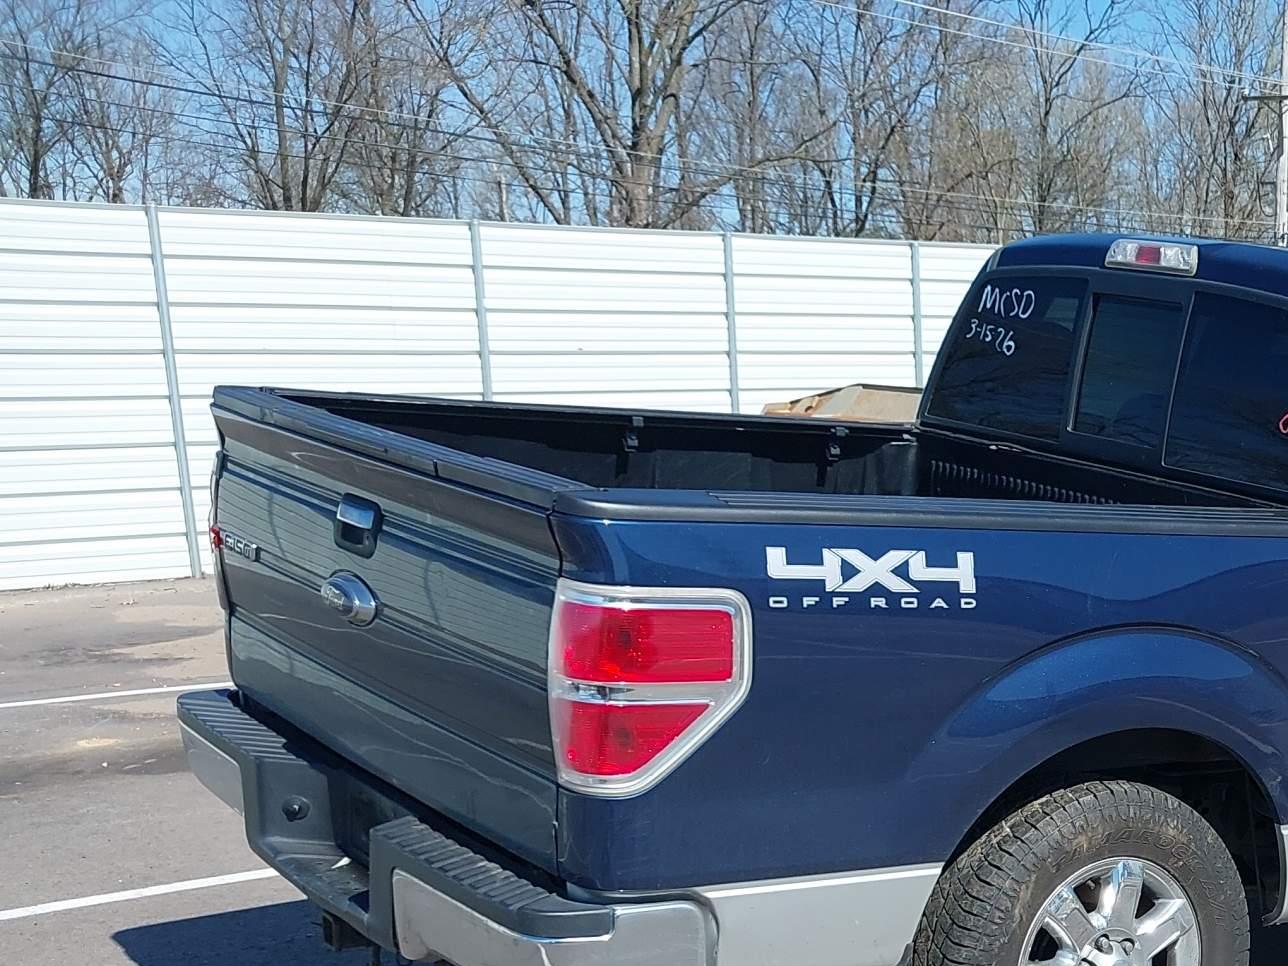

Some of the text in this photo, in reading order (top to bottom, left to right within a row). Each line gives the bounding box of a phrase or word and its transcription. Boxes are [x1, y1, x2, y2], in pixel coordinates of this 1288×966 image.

[978, 284, 1035, 319] MCSD
[768, 596, 977, 609] OFF ROAD
